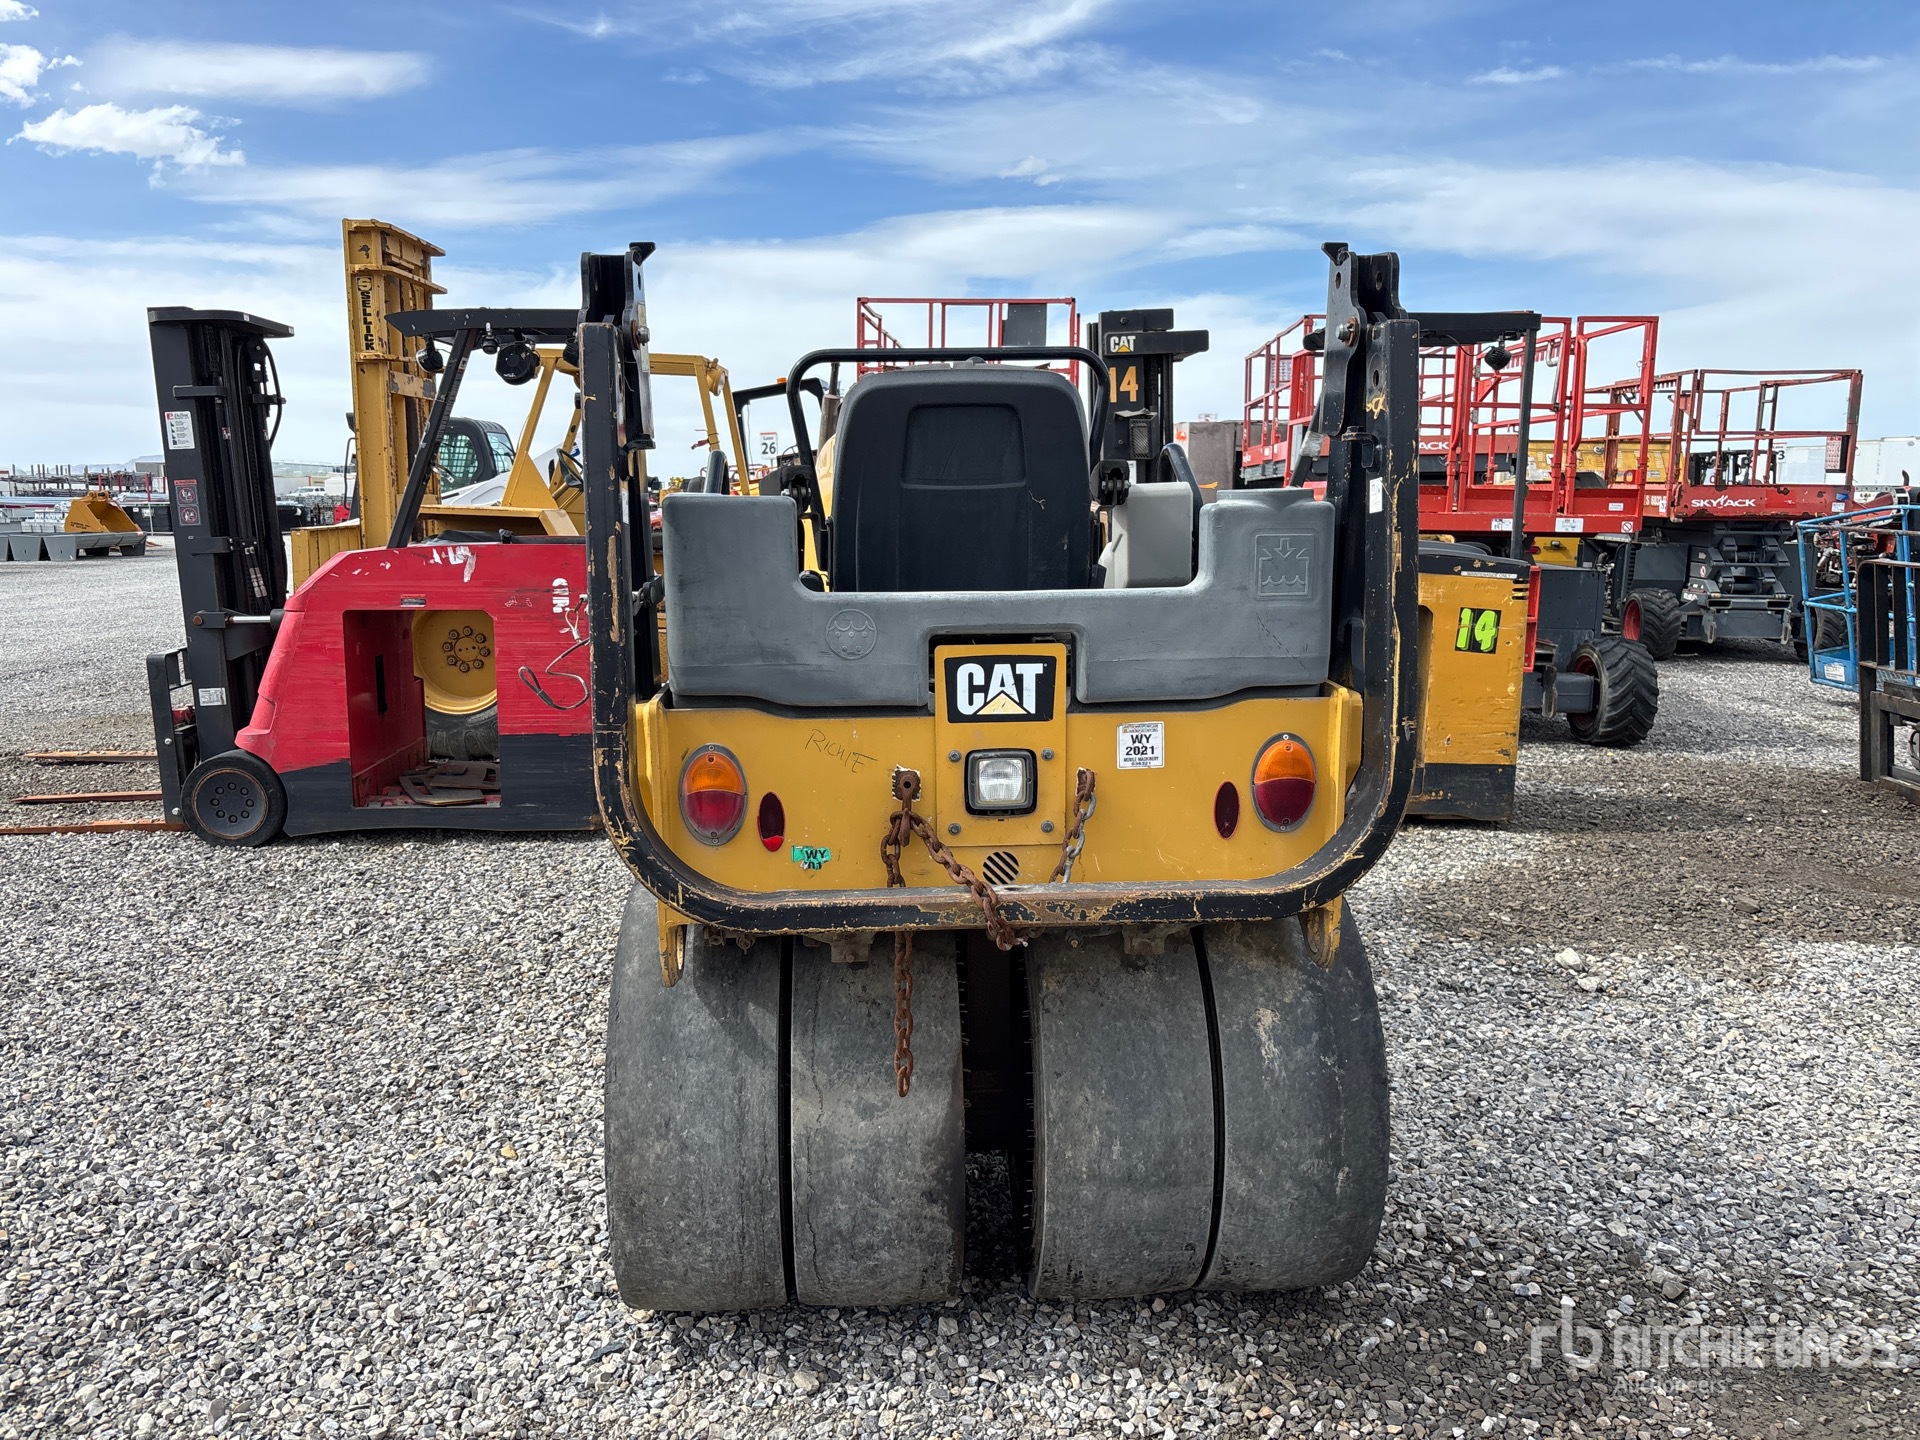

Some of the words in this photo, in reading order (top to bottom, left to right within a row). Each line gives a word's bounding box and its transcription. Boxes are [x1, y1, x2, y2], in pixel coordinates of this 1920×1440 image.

[360, 291, 375, 350] SELLICK
[1110, 336, 1136, 352] CAT
[1109, 366, 1138, 403] 14
[761, 442, 776, 455] 26
[1691, 495, 1756, 508] SKYJACK
[1456, 608, 1498, 652] 14
[957, 663, 1044, 715] CAT
[1130, 734, 1152, 744] WY
[804, 728, 879, 774] RICHIE
[1125, 745, 1155, 756] 2021
[805, 849, 827, 860] WY
